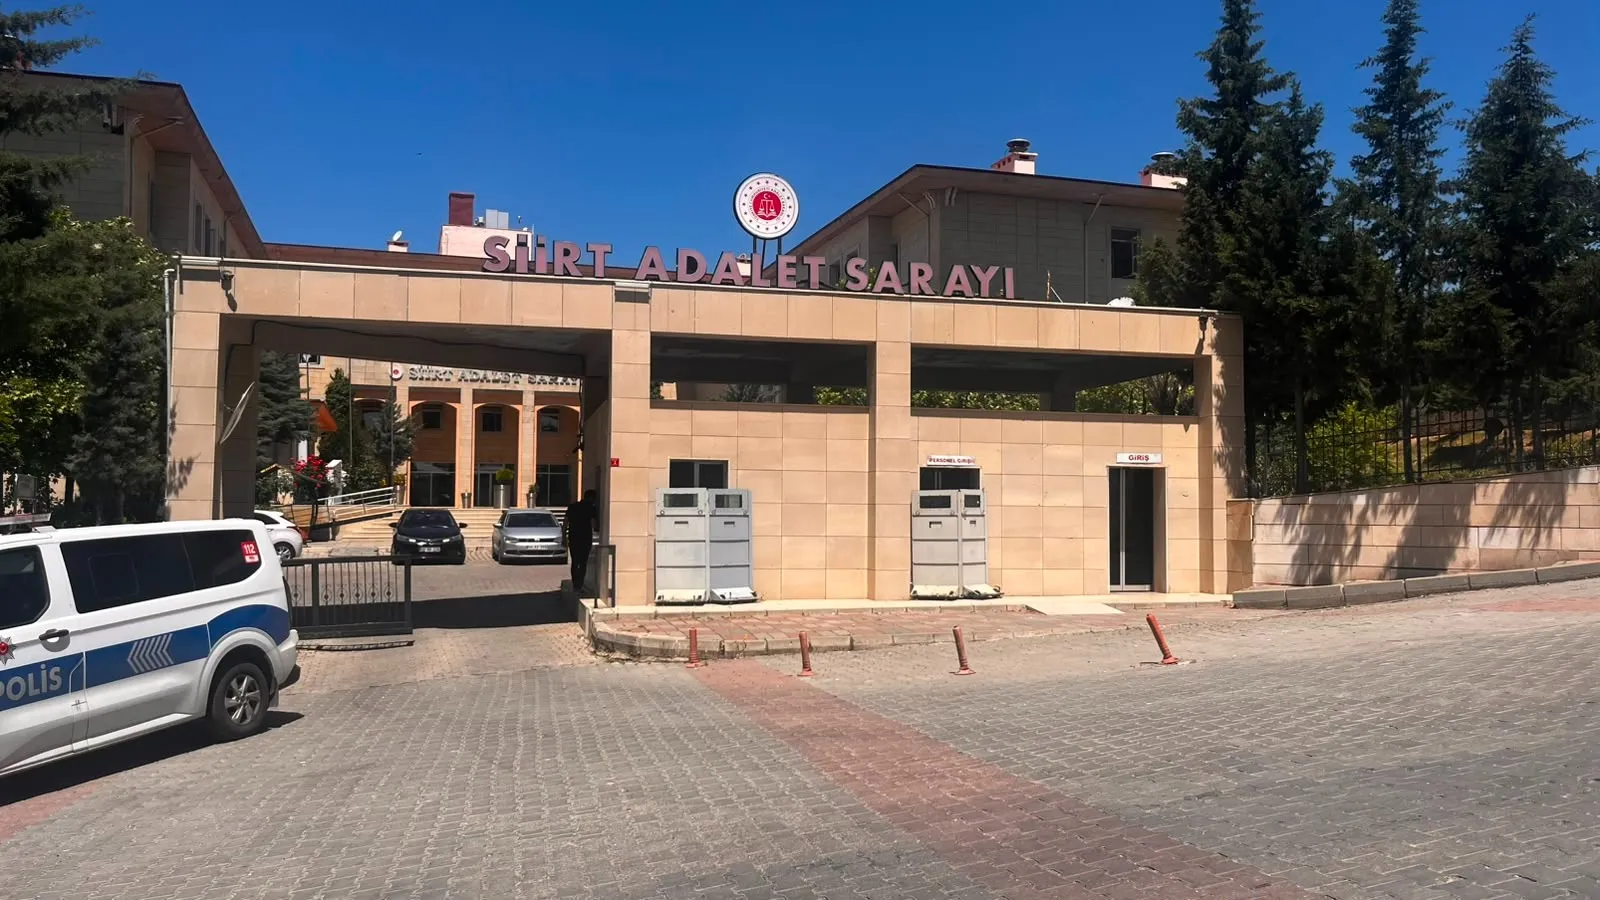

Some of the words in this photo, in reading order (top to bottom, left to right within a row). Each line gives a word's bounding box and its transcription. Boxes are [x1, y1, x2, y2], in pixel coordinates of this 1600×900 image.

[633, 245, 826, 290] ADALET
[845, 257, 1015, 299] SARAYI
[458, 369, 522, 384] ADALET
[527, 373, 583, 386] SARAY
[243, 543, 256, 555] 112
